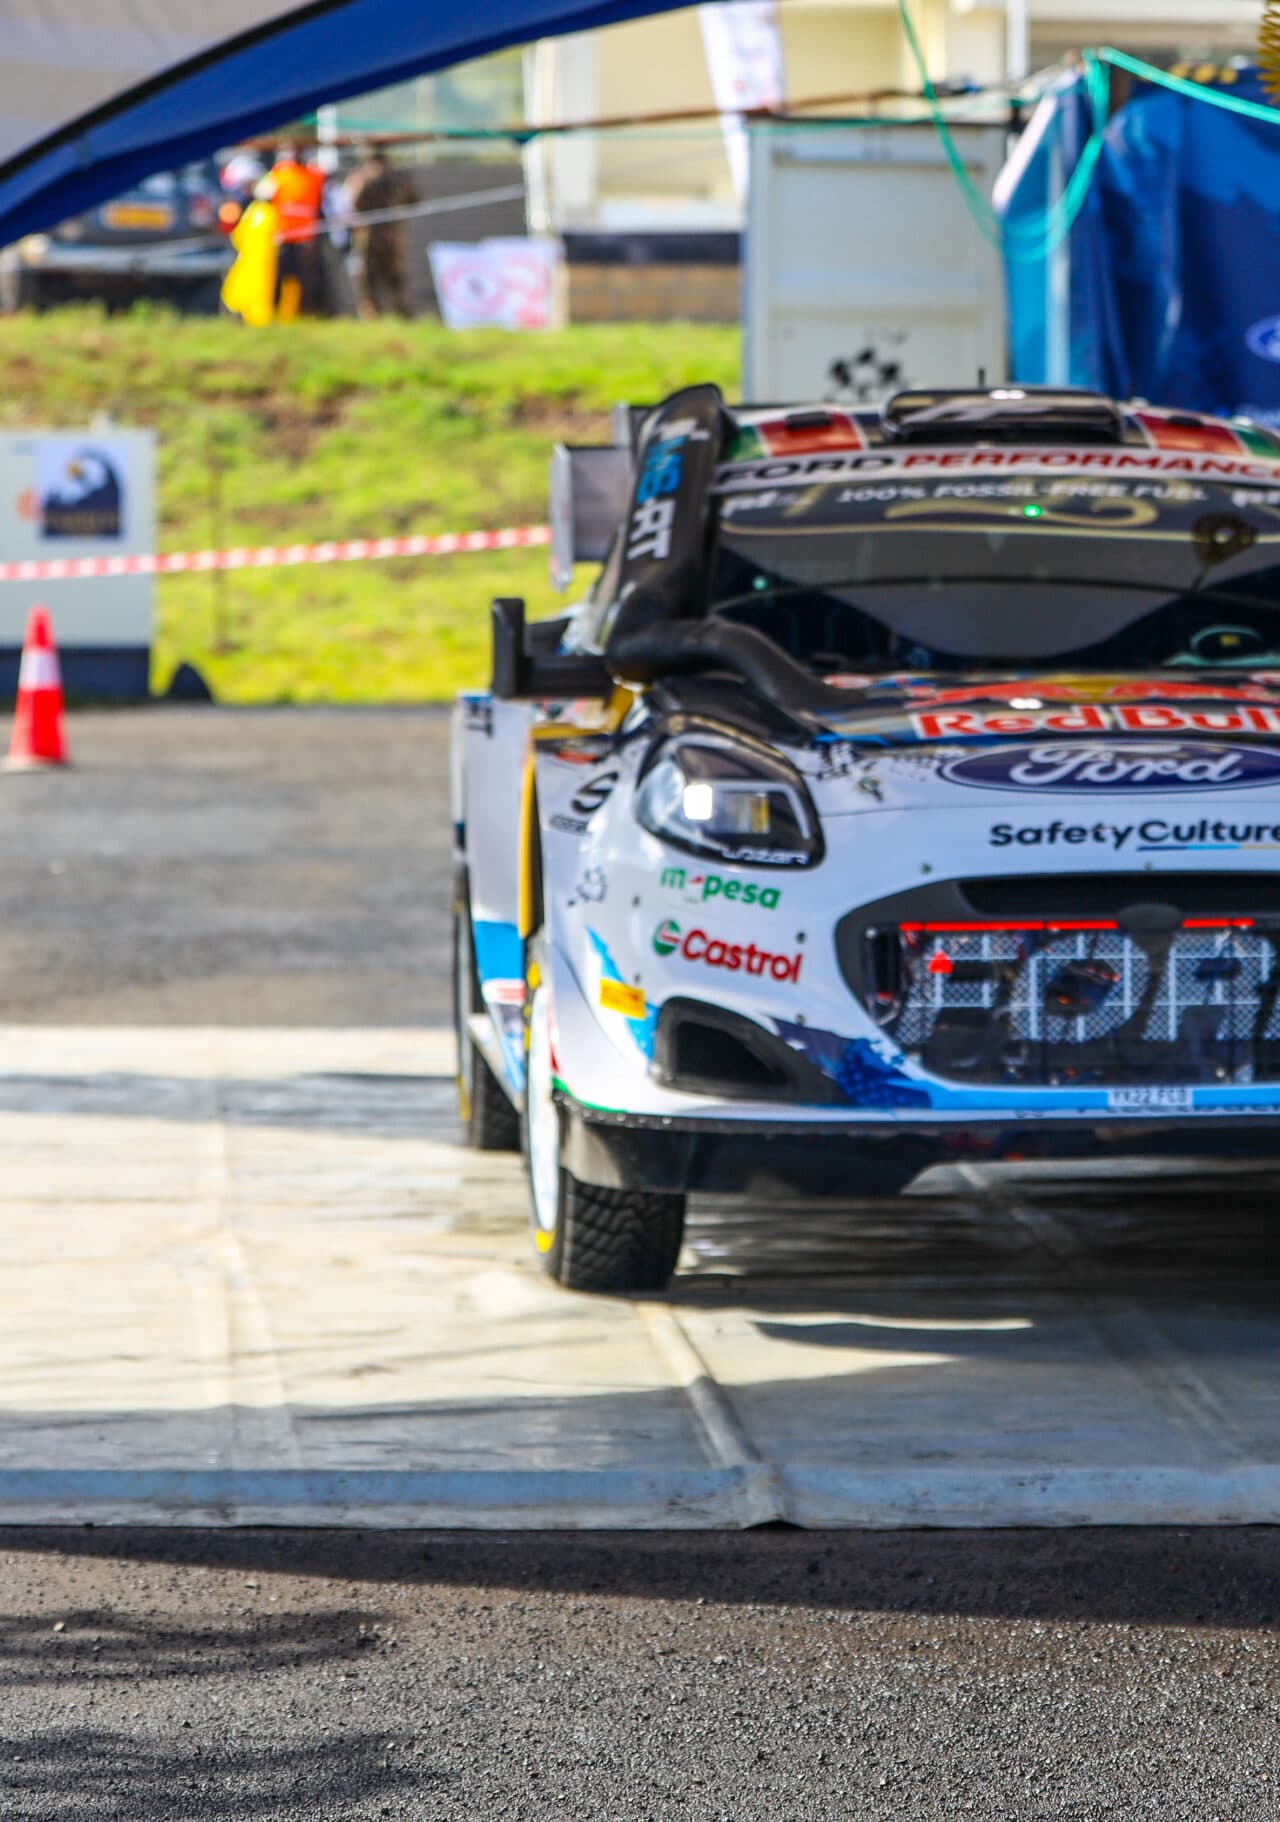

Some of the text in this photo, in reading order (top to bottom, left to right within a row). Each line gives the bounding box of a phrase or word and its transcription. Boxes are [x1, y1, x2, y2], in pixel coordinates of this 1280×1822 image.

[717, 456, 895, 483] FORD
[909, 704, 1107, 739] Red
[1008, 744, 1242, 785] Ford
[681, 929, 803, 984] Castrol
